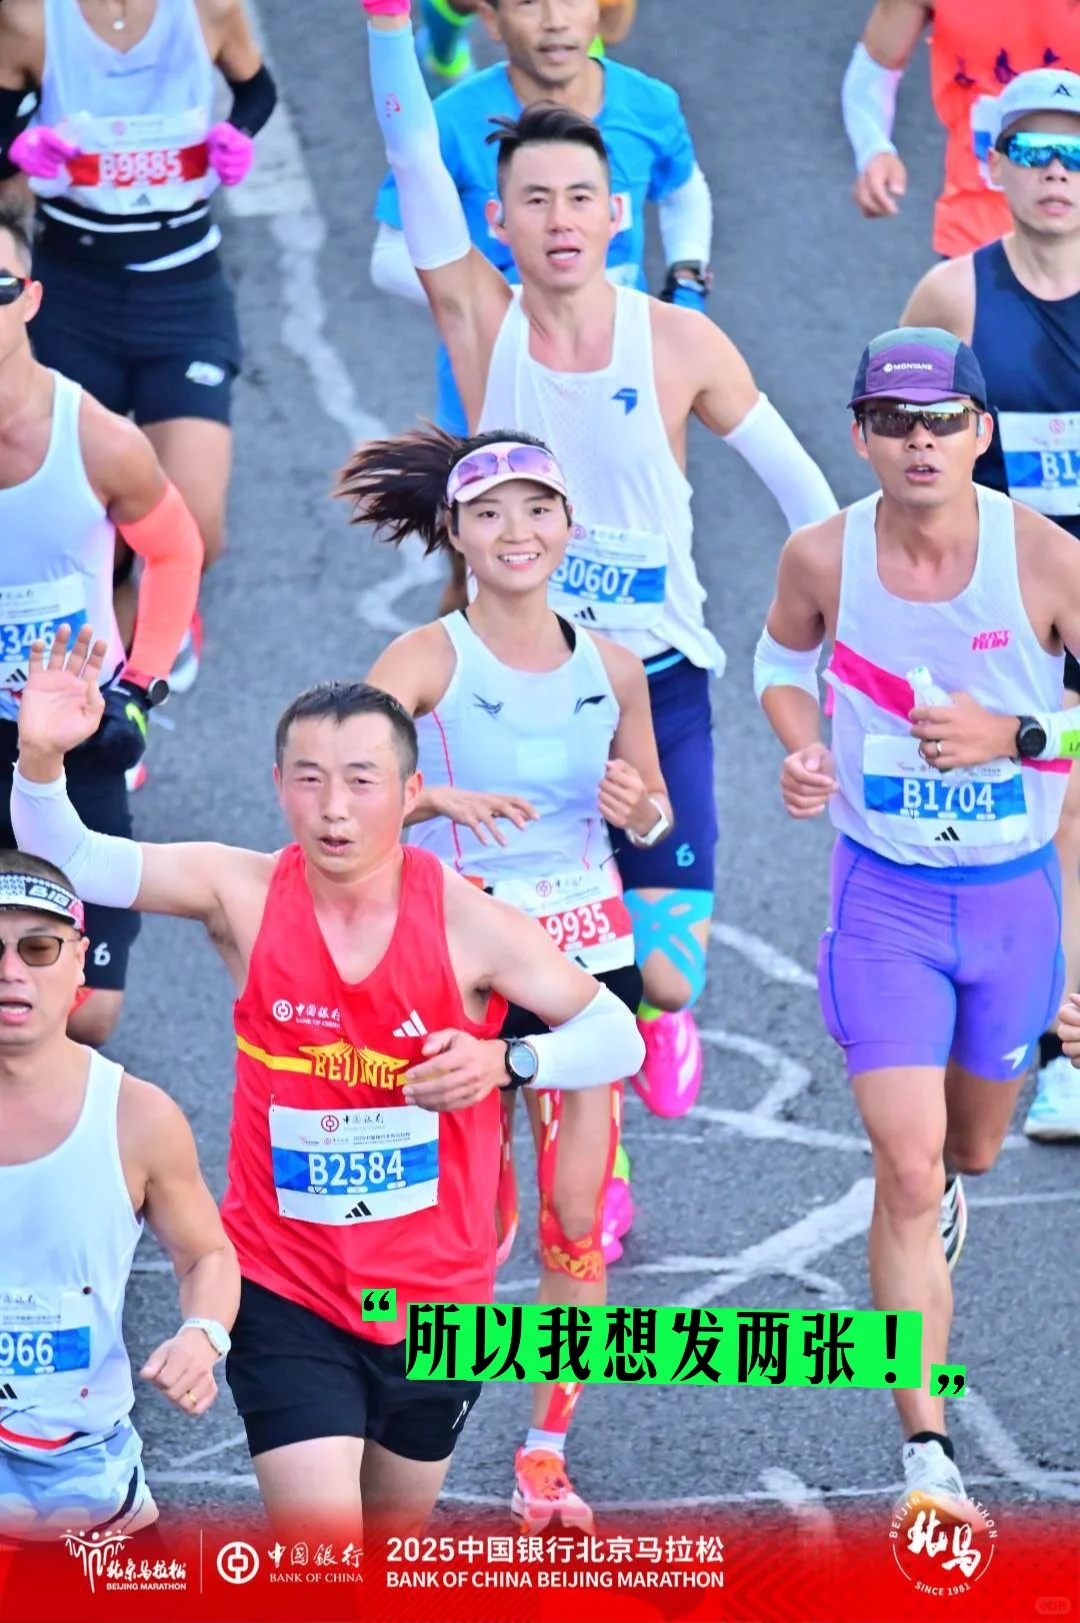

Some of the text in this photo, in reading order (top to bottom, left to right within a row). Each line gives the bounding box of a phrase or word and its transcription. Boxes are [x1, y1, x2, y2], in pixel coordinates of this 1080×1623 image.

[98, 152, 183, 182] B9885
[1040, 451, 1080, 481] B1
[0, 620, 56, 655] 346
[903, 778, 995, 814] B1704
[546, 903, 611, 945] 9935
[303, 1040, 408, 1090] BEIJING
[308, 1150, 404, 1186] B2584
